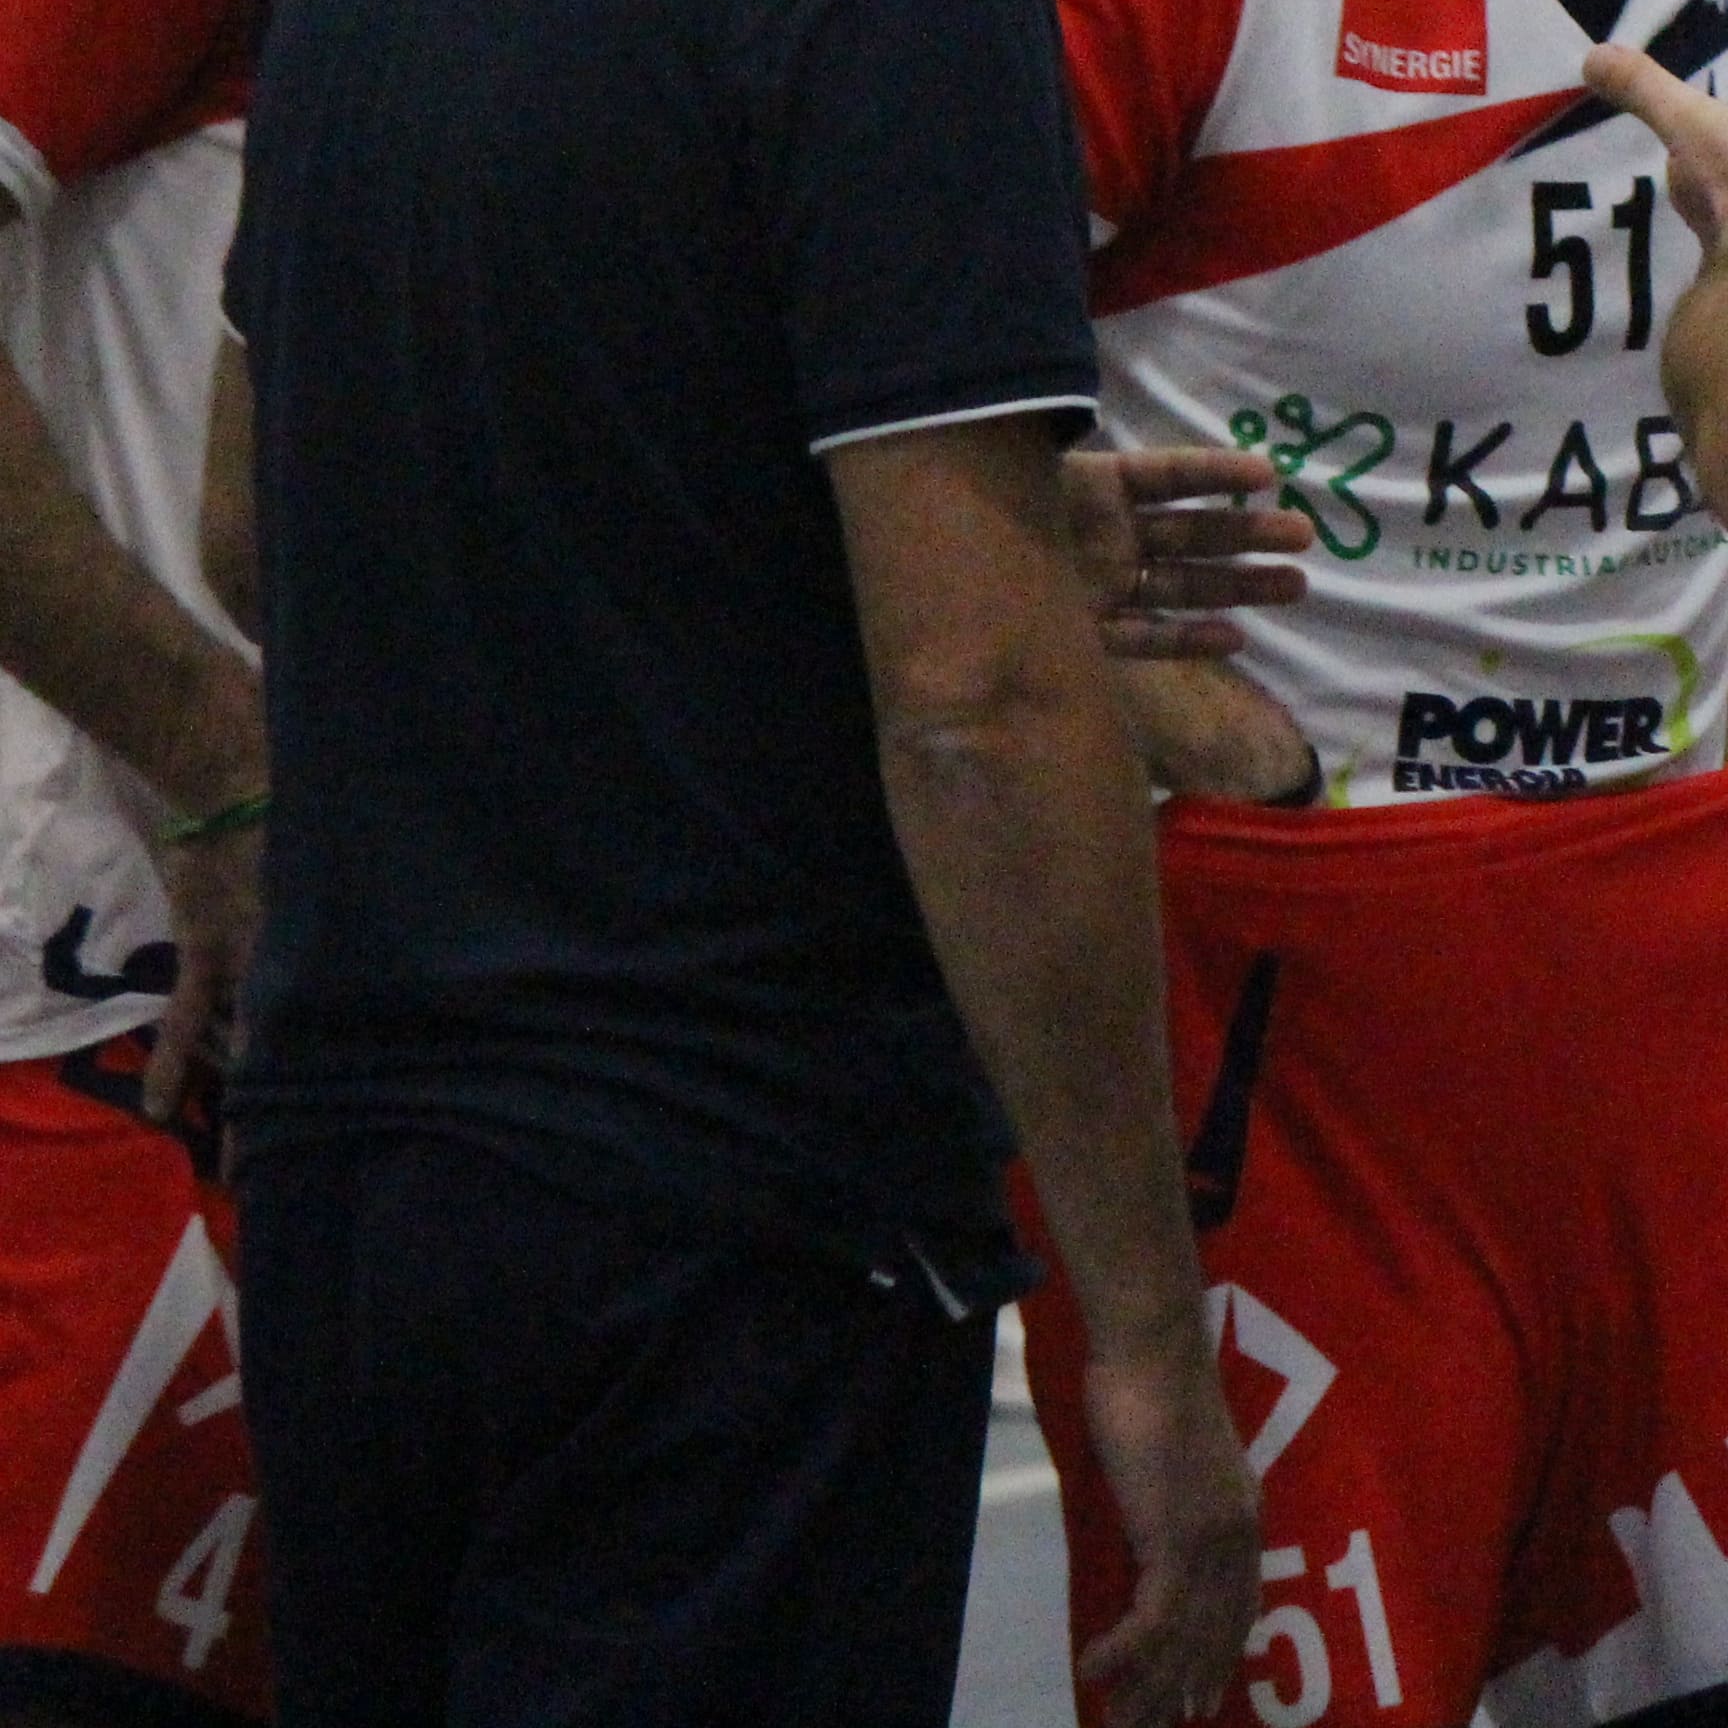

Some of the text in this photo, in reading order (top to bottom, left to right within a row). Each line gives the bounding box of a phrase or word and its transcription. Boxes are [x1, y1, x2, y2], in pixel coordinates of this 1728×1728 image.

[1342, 32, 1484, 83] SYNERGIE
[1526, 175, 1655, 358] 51
[1423, 416, 1703, 532] KAB
[1397, 690, 1671, 765] POWER
[156, 1494, 259, 1671] 4
[1247, 1528, 1403, 1728] 51
